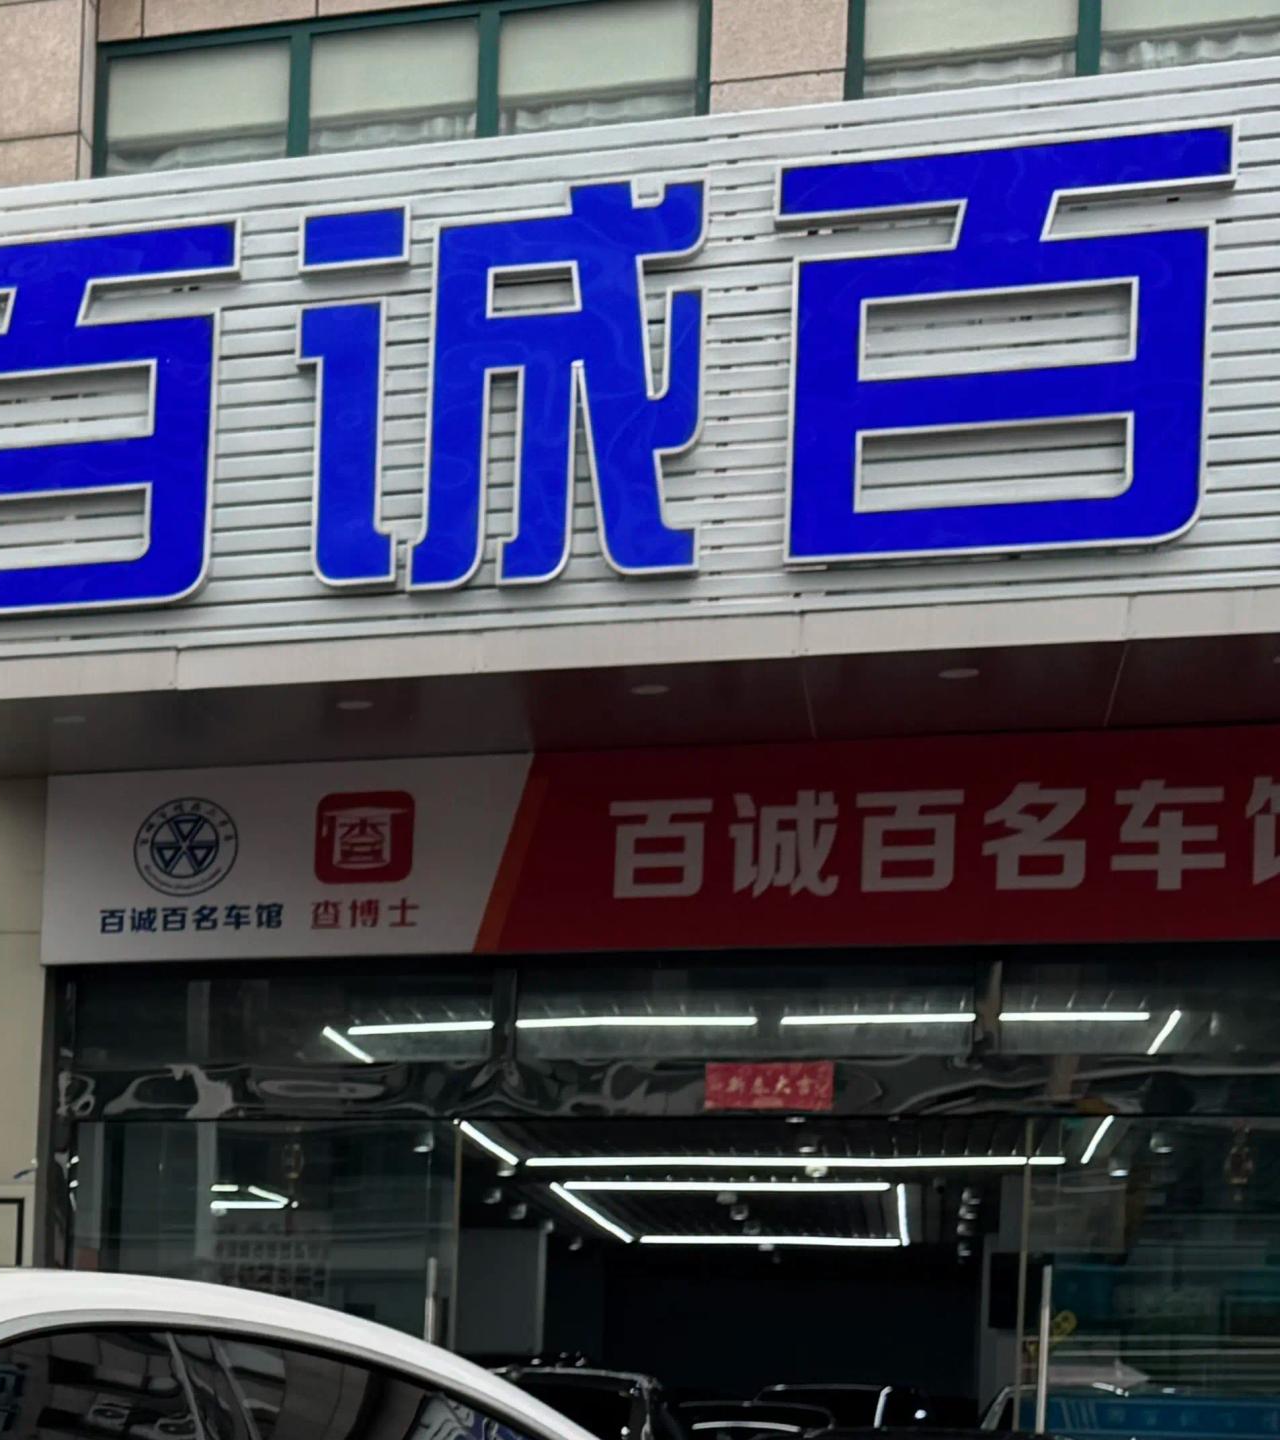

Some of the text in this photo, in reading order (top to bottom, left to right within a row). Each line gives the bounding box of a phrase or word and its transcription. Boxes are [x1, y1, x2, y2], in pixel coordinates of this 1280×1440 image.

[99, 903, 285, 934] 百诚百名车馆
